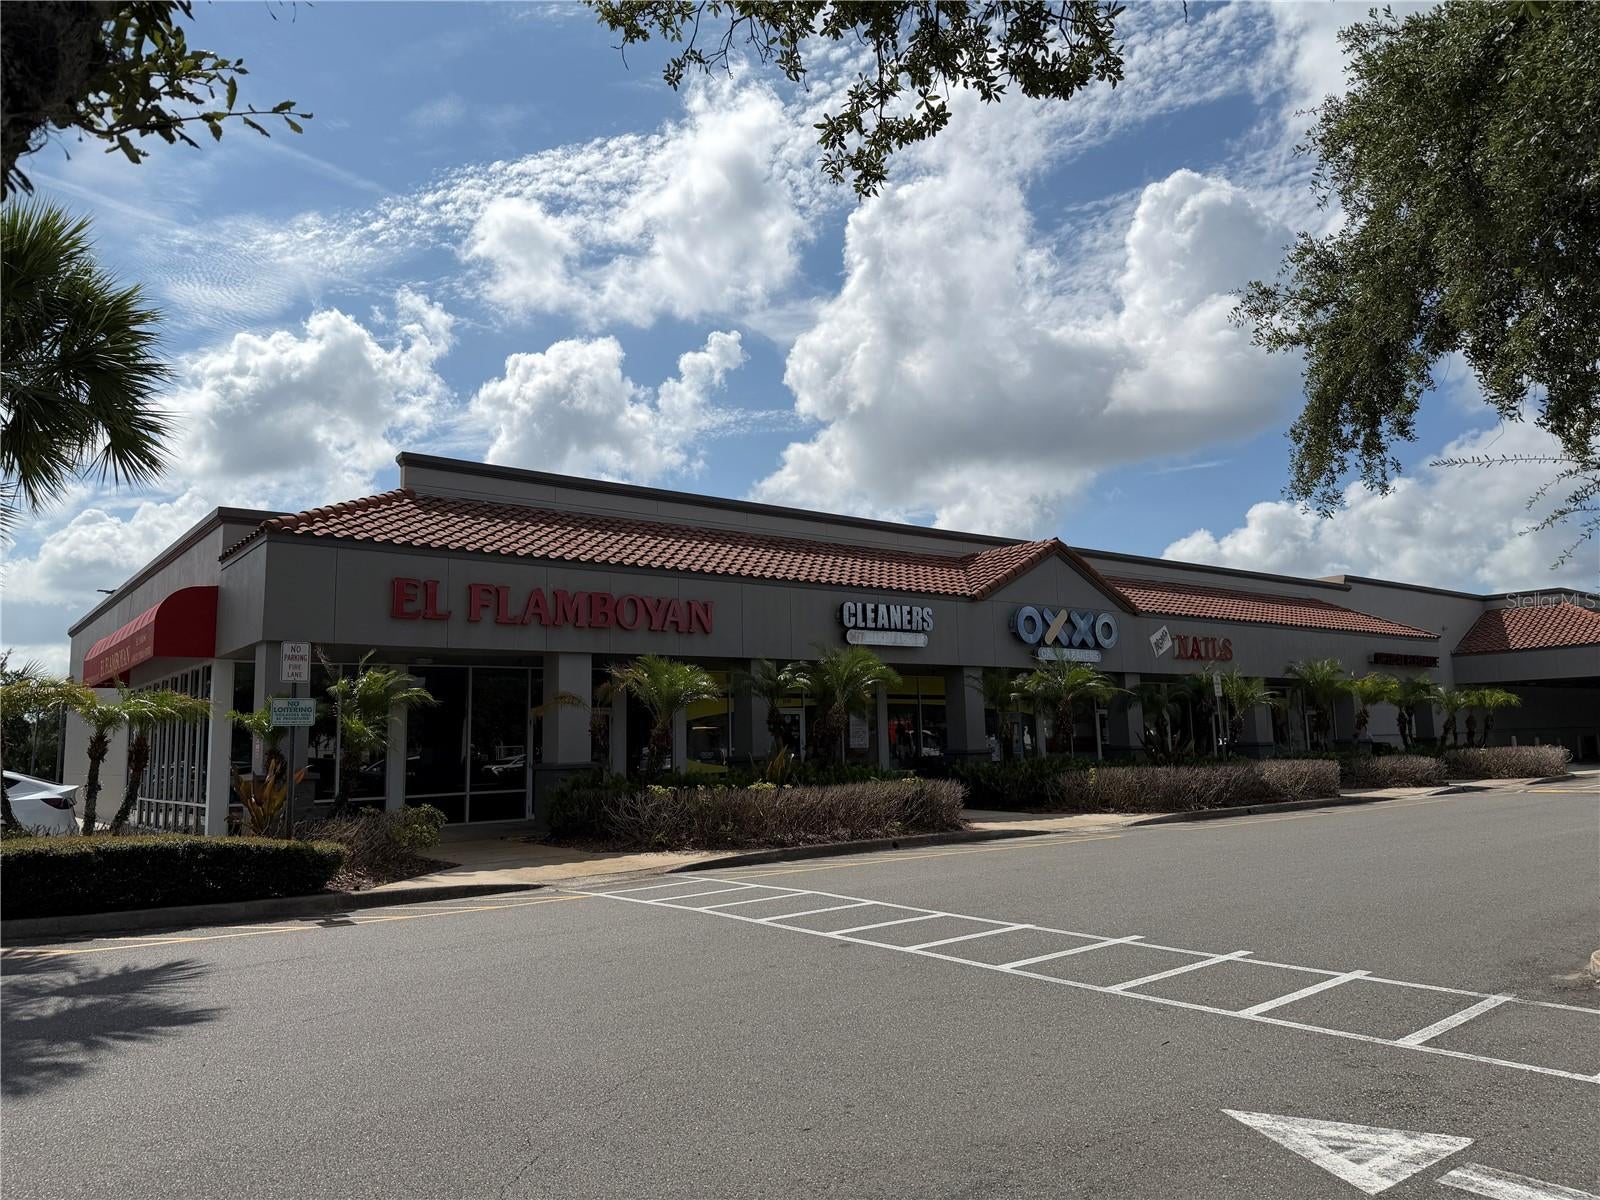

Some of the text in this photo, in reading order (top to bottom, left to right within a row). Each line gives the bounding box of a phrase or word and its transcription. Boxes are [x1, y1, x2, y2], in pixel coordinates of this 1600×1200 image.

[391, 577, 715, 634] EL FLAMBOYAN
[842, 601, 934, 632] CLEANERS
[1016, 605, 1119, 649] OXXO
[284, 654, 308, 662] PARKING
[290, 645, 302, 653] NO
[288, 663, 303, 671] FIRE
